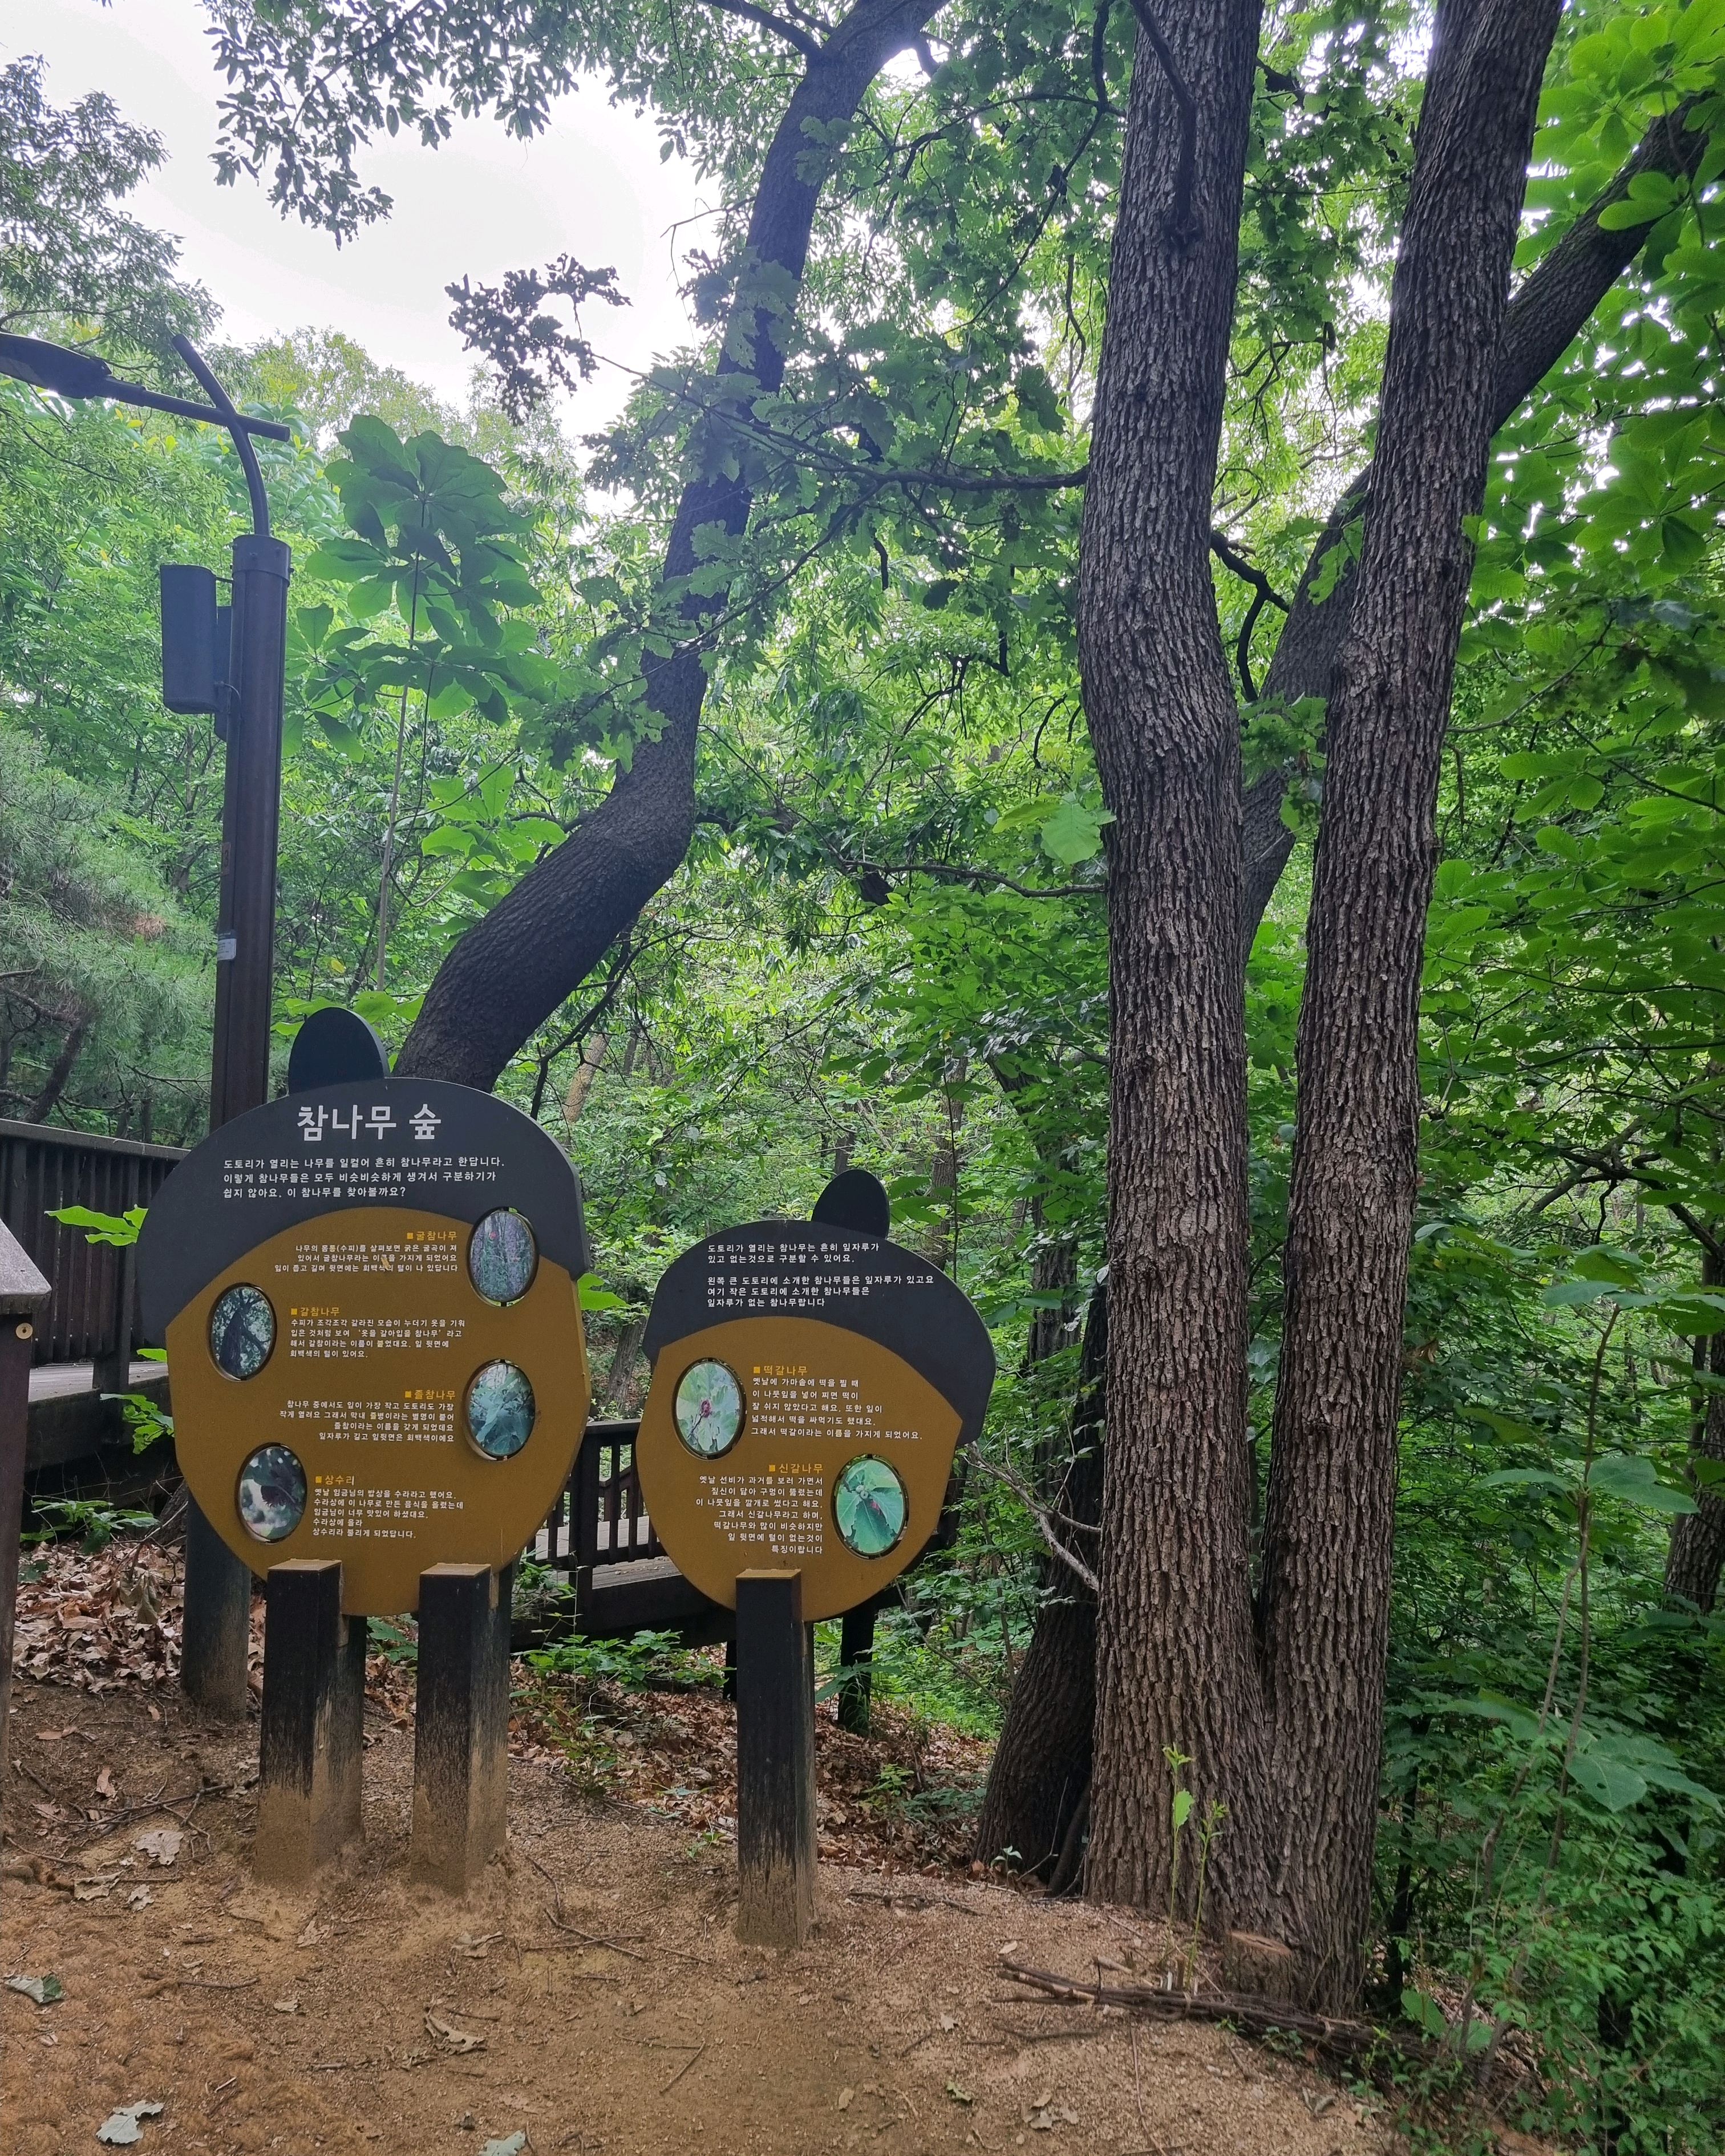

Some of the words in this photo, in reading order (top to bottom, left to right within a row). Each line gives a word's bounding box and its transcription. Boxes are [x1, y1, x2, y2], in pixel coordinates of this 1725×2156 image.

[297, 1104, 396, 1141] 참나무
[409, 1104, 441, 1140] 숲
[224, 1159, 264, 1169] 도토리가
[270, 1158, 299, 1169] 열리는
[305, 1158, 334, 1168] 나무를
[340, 1158, 369, 1168] 일컬어
[375, 1157, 394, 1167] 흔히
[400, 1157, 452, 1167] 참나무라고
[458, 1157, 504, 1166] 한답니다.
[224, 1174, 253, 1184] 이렇게
[258, 1173, 309, 1183] 참나무들은
[314, 1173, 334, 1182] 모두
[339, 1172, 401, 1182] 비슷비슷하게
[407, 1172, 437, 1182] 생겨서
[443, 1171, 496, 1181] 구분하기가
[223, 1188, 242, 1198] 쉽지
[248, 1188, 281, 1198] 않아요.
[287, 1188, 295, 1197] 이
[301, 1187, 341, 1197] 참나무를
[347, 1186, 406, 1197] 찾아볼까요?
[416, 1231, 456, 1241] 굴참나무
[779, 1243, 815, 1252] 참나무는
[820, 1243, 837, 1251] 흔히
[843, 1243, 879, 1251] 잎자루가
[708, 1255, 724, 1263] 있고
[730, 1254, 774, 1263] 없는것으로
[779, 1254, 806, 1263] 구분할
[811, 1254, 819, 1263] 수
[824, 1254, 854, 1262] 있어요.
[707, 1276, 724, 1285] 왼쪽
[729, 1276, 737, 1285] 큰
[783, 1276, 809, 1284] 소개한
[814, 1275, 860, 1284] 참나무들은
[865, 1275, 901, 1284] 잎자루가
[906, 1275, 933, 1284] 있고요
[707, 1287, 724, 1296] 여기
[729, 1287, 746, 1296] 작은
[792, 1287, 819, 1295] 소개한
[824, 1287, 869, 1295] 참나무들은
[707, 1298, 743, 1307] 잎자루가
[748, 1298, 765, 1307] 없는
[770, 1298, 824, 1307] 참나무랍니다
[300, 1307, 339, 1316] 갈참나무
[764, 1365, 807, 1376] 떡갈나무
[764, 1390, 797, 1399] 나뭇잎을
[764, 1402, 779, 1411] 쉬지
[780, 1428, 822, 1436] 떡갈이라는
[885, 1430, 922, 1439] 되었어요.
[779, 1463, 823, 1474] 신갈나무
[325, 1475, 354, 1485] 상수리
[748, 1510, 798, 1519] 신갈나무라고
[313, 1518, 343, 1526] 수라상에
[714, 1521, 756, 1530] 떡갈나무와
[780, 1522, 823, 1531] 비슷하지만
[313, 1527, 343, 1536] 상수리라
[374, 1530, 416, 1538] 되었답니다.
[789, 1534, 822, 1542] 없는것이
